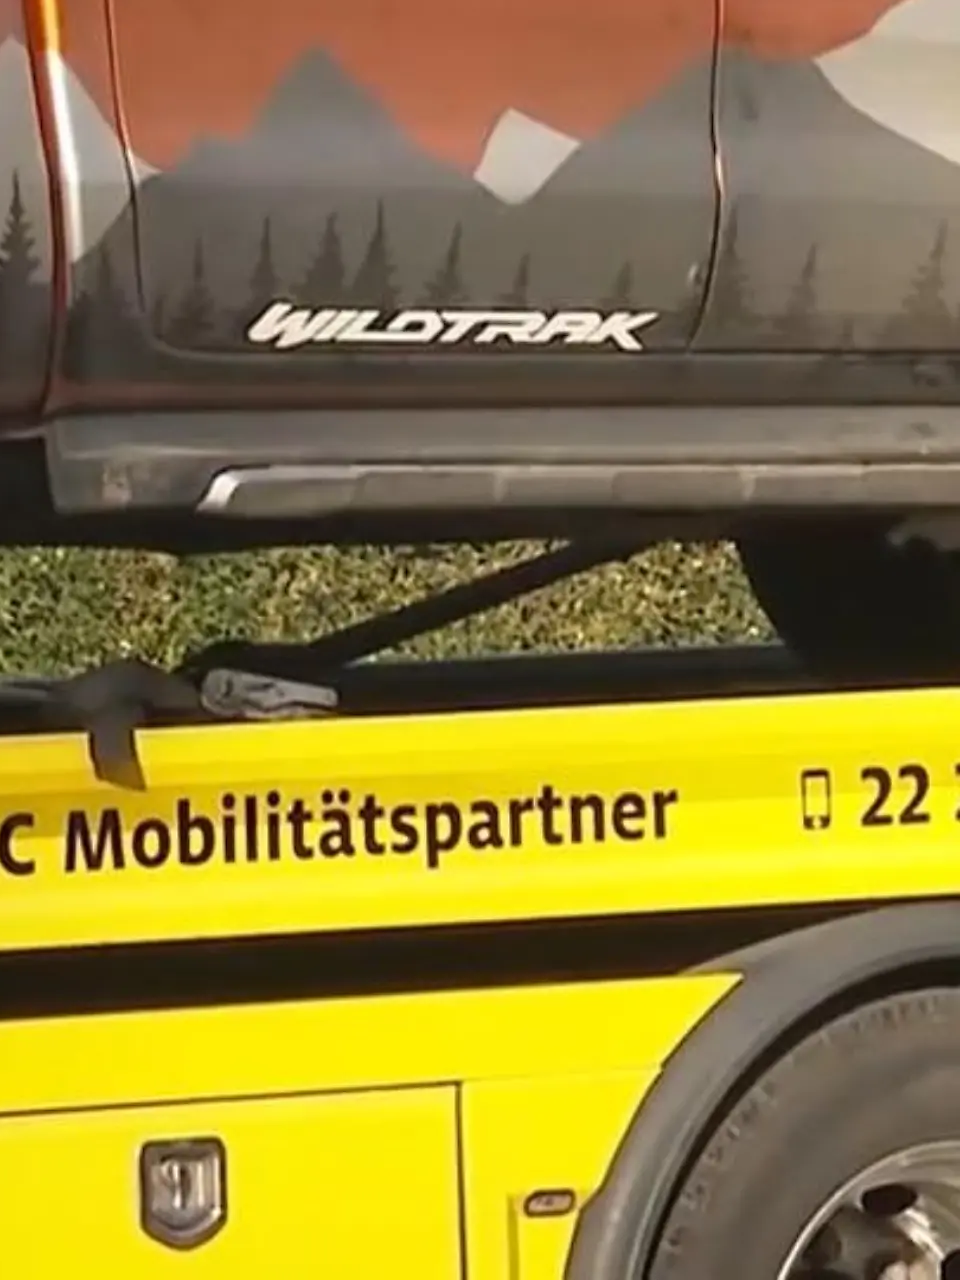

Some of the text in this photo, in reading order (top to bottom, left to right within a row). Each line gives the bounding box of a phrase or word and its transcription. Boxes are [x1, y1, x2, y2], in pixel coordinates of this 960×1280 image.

[248, 303, 658, 349] WILDTRAK
[860, 764, 931, 826] 22
[64, 785, 678, 872] Mobilitätspartner
